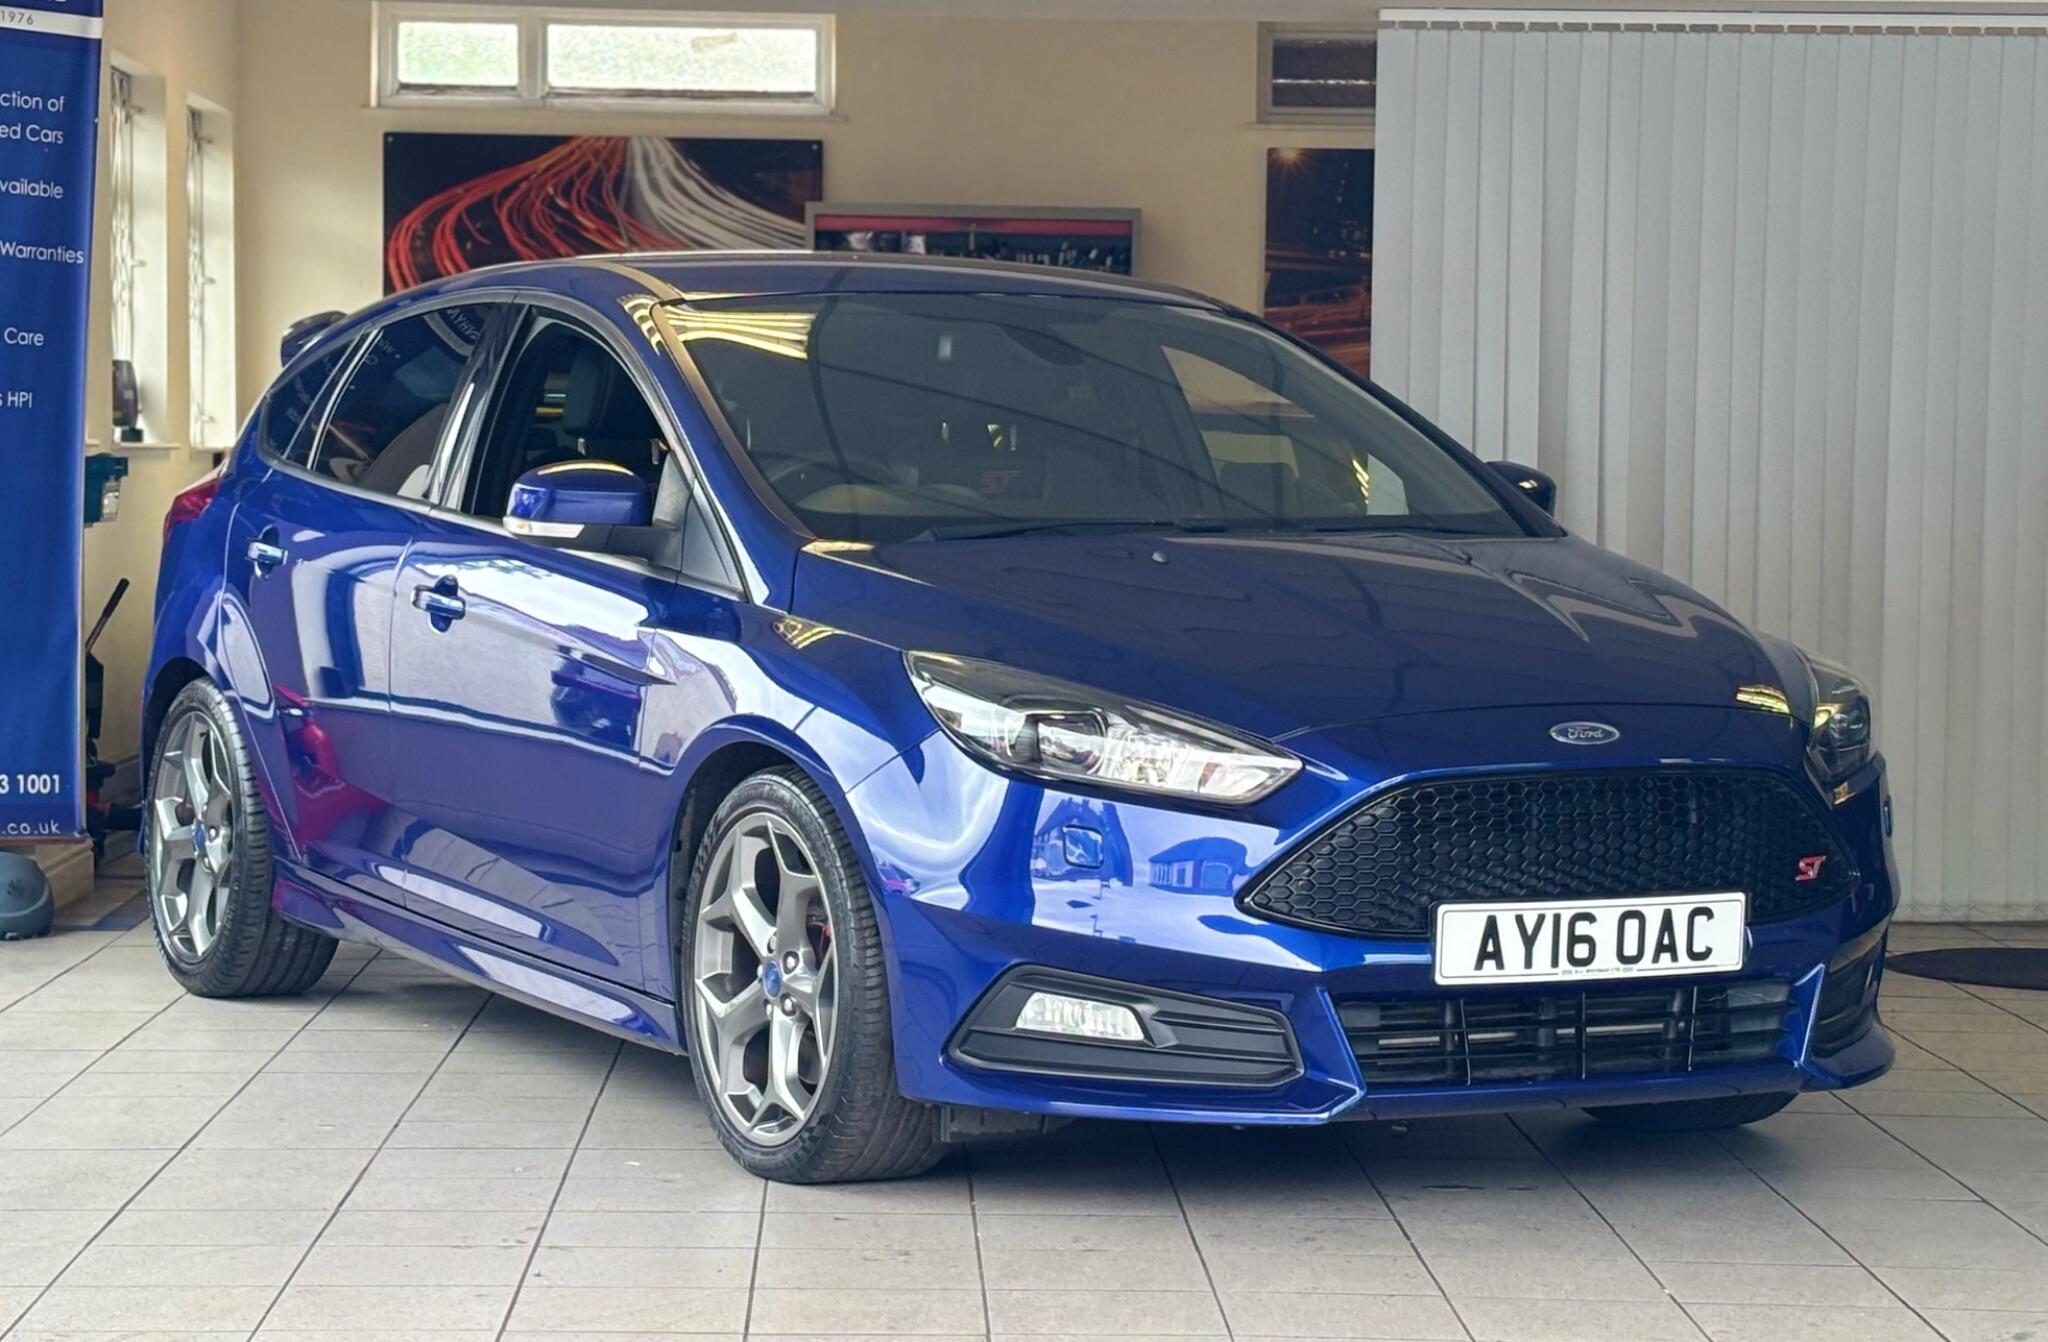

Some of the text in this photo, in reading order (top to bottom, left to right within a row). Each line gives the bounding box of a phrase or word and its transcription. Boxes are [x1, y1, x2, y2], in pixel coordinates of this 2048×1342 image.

[1, 9, 34, 26] 1976
[0, 91, 65, 112] ction of
[0, 123, 64, 144] ed Cars
[0, 177, 64, 199] vailable
[0, 239, 85, 264] Warranties
[4, 326, 45, 346] Care
[7, 390, 33, 408] HPI
[16, 773, 60, 795] 1001
[1795, 855, 1827, 881] ST
[1473, 905, 1715, 971] AY16 OAC
